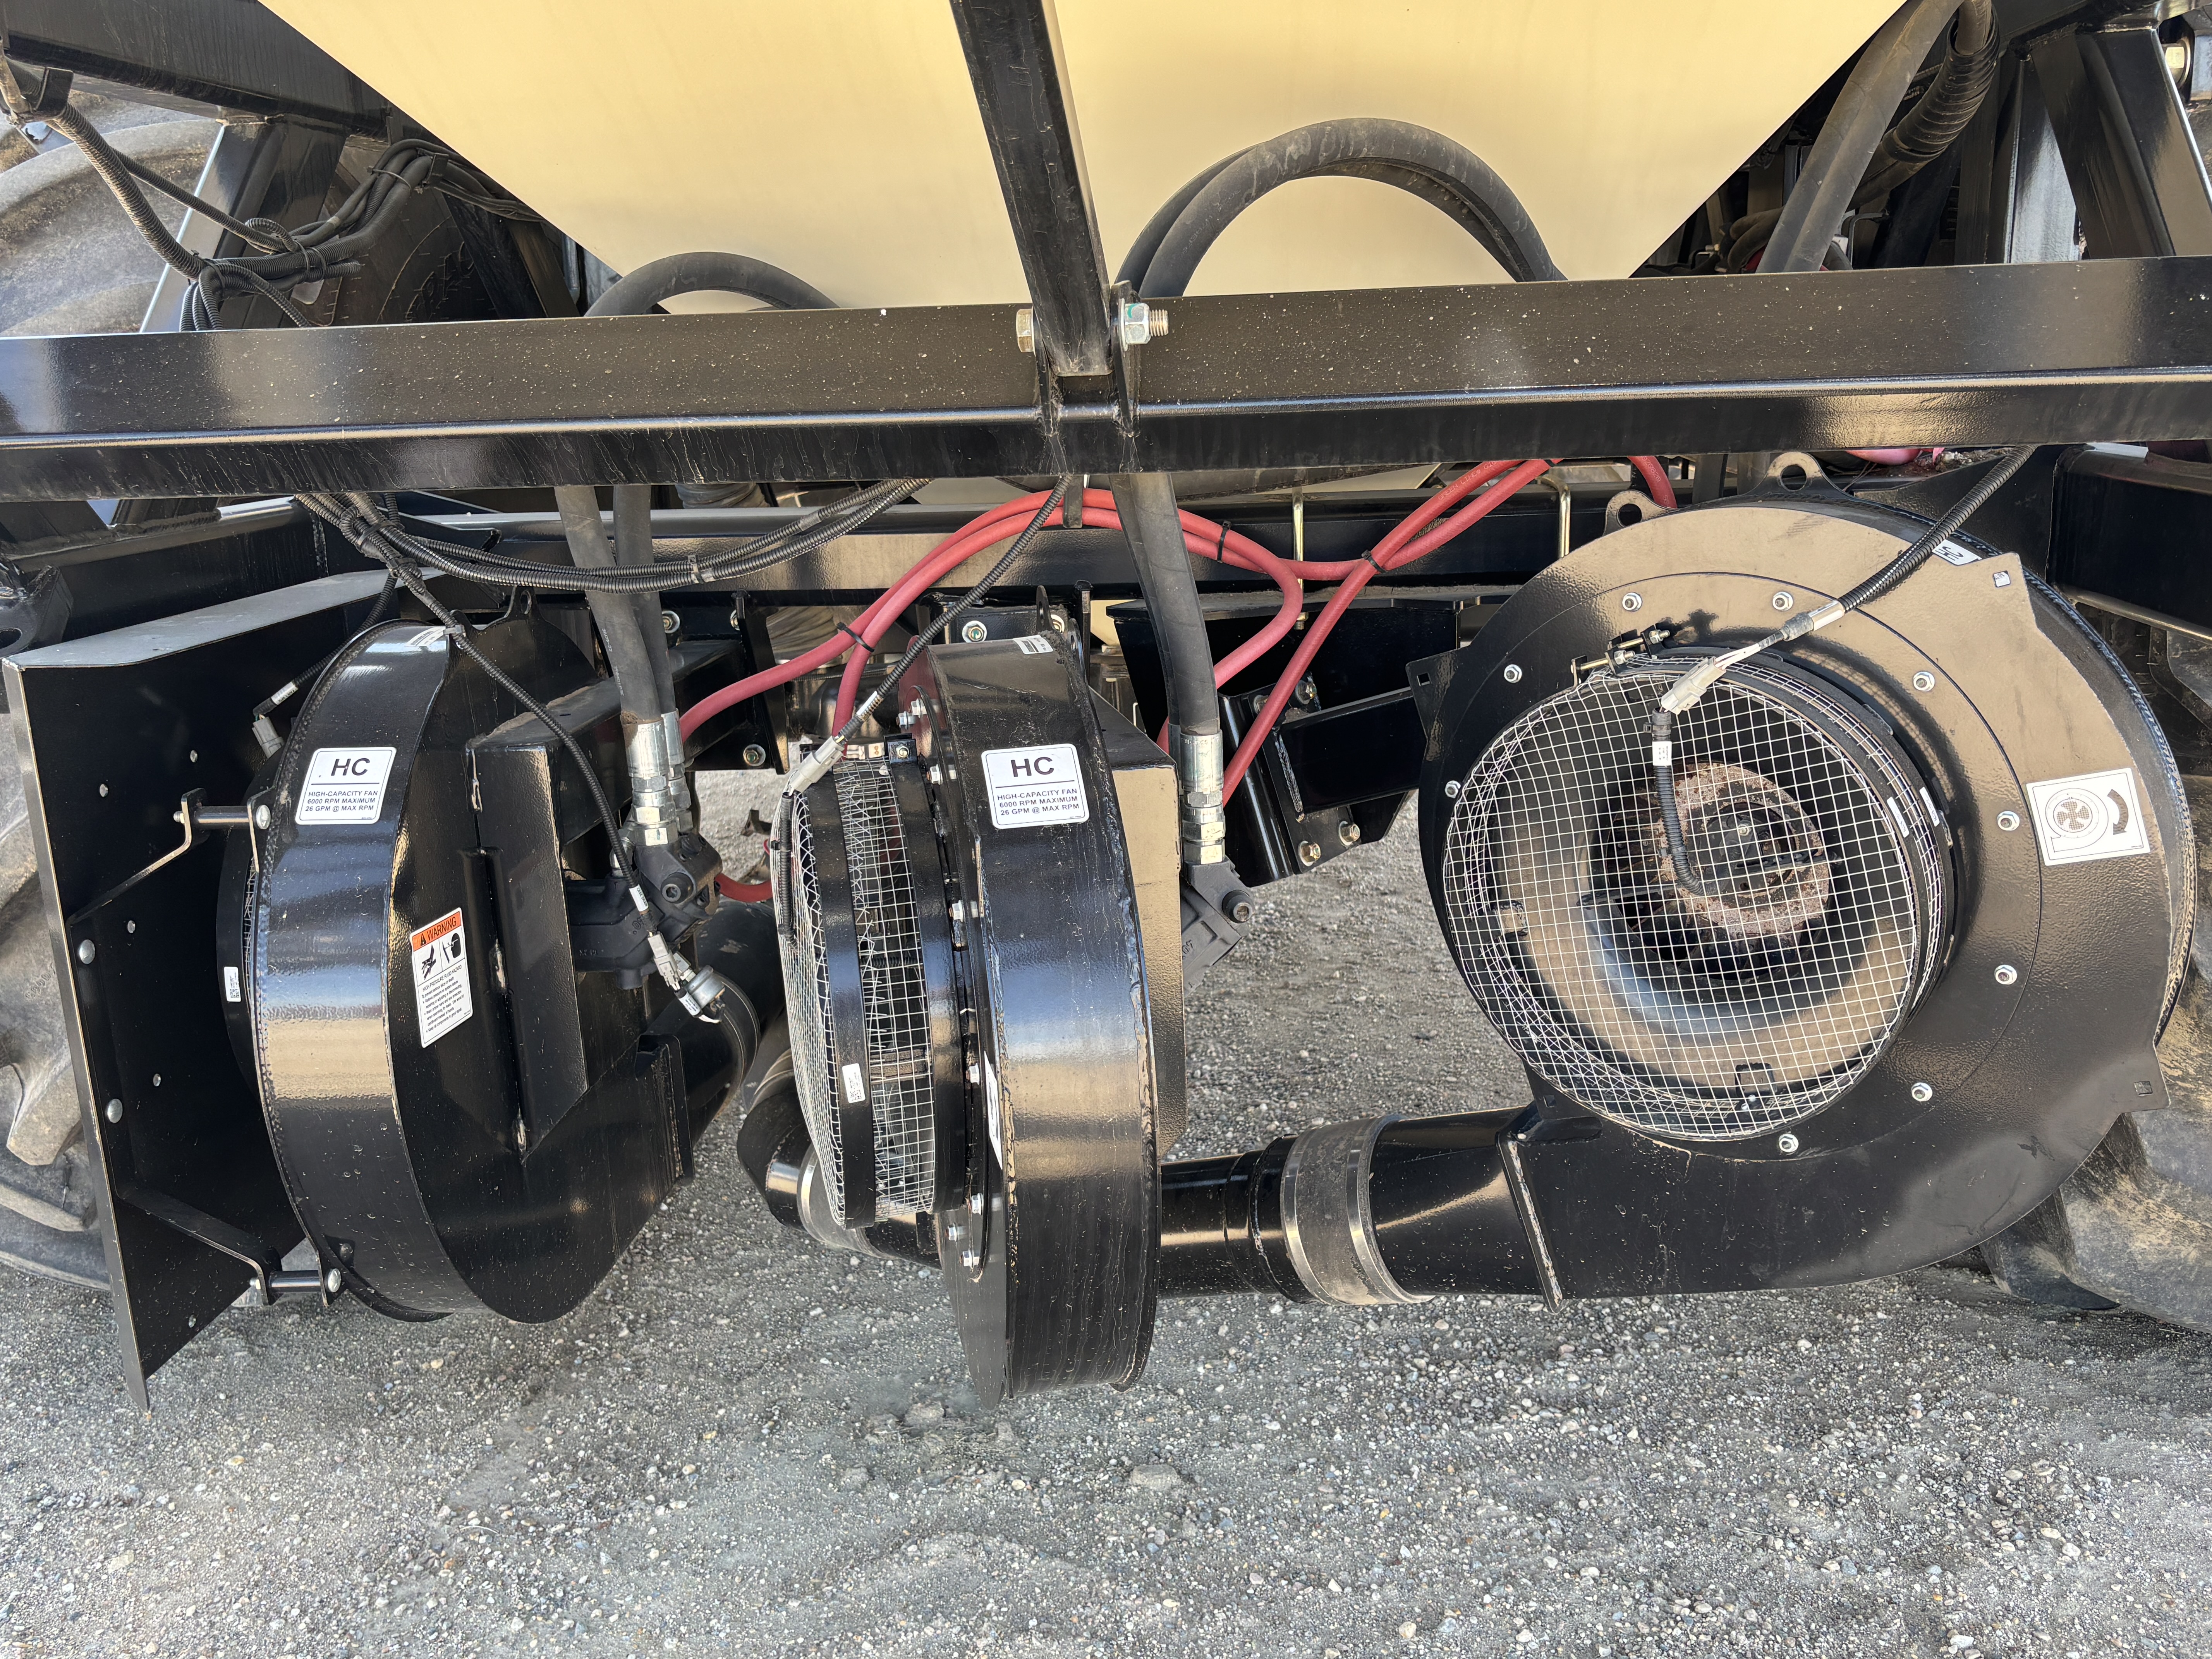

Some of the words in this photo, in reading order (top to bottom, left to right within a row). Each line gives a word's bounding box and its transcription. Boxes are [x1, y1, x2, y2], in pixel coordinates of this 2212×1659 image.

[1438, 484, 1458, 500] GREEN
[1935, 546, 1964, 561] HC
[331, 758, 370, 776] HC
[1011, 756, 1055, 778] HC
[997, 790, 1060, 801] HIGH-CAPACITY
[1039, 796, 1078, 805] MAXIMUM
[427, 916, 457, 941] WARNING
